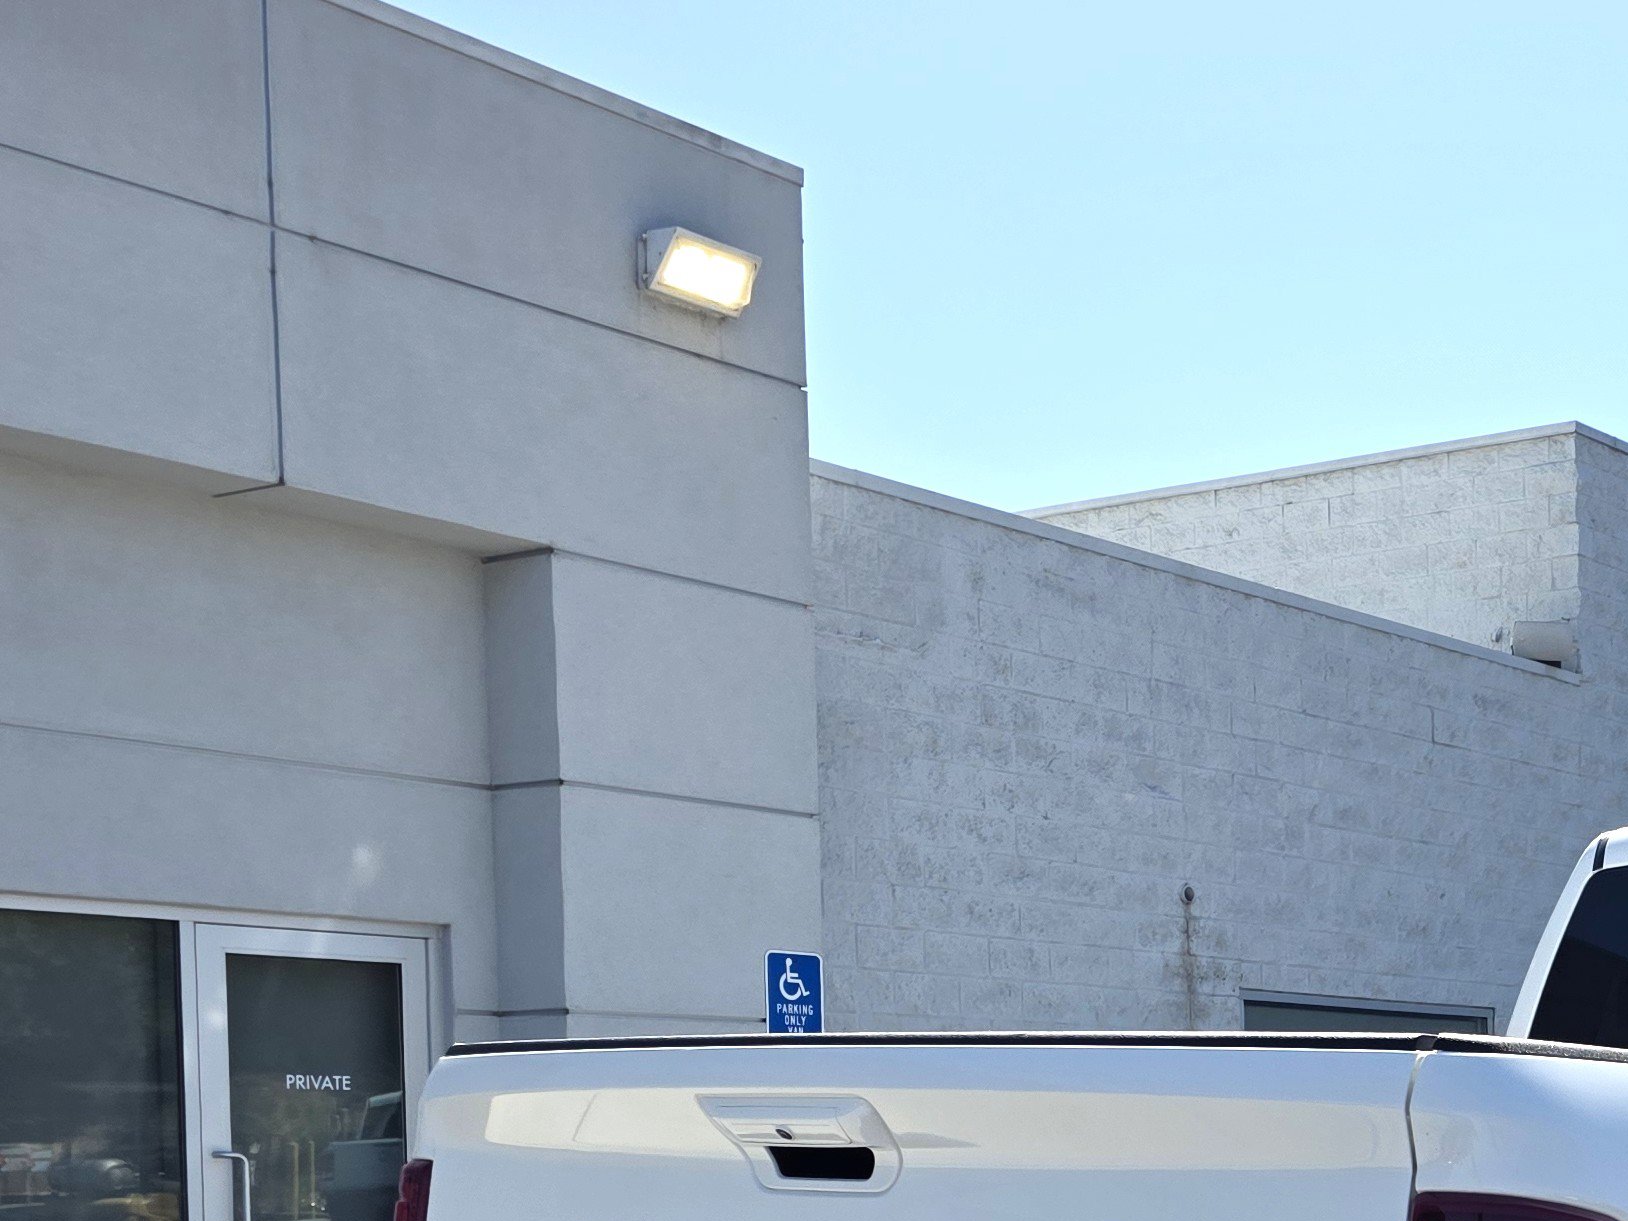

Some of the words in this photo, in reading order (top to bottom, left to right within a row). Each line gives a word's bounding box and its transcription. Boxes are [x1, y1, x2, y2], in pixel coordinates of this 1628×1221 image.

[777, 1003, 814, 1016] PARKING
[785, 1015, 807, 1026] ONLY
[286, 1074, 352, 1091] PRIVATE
